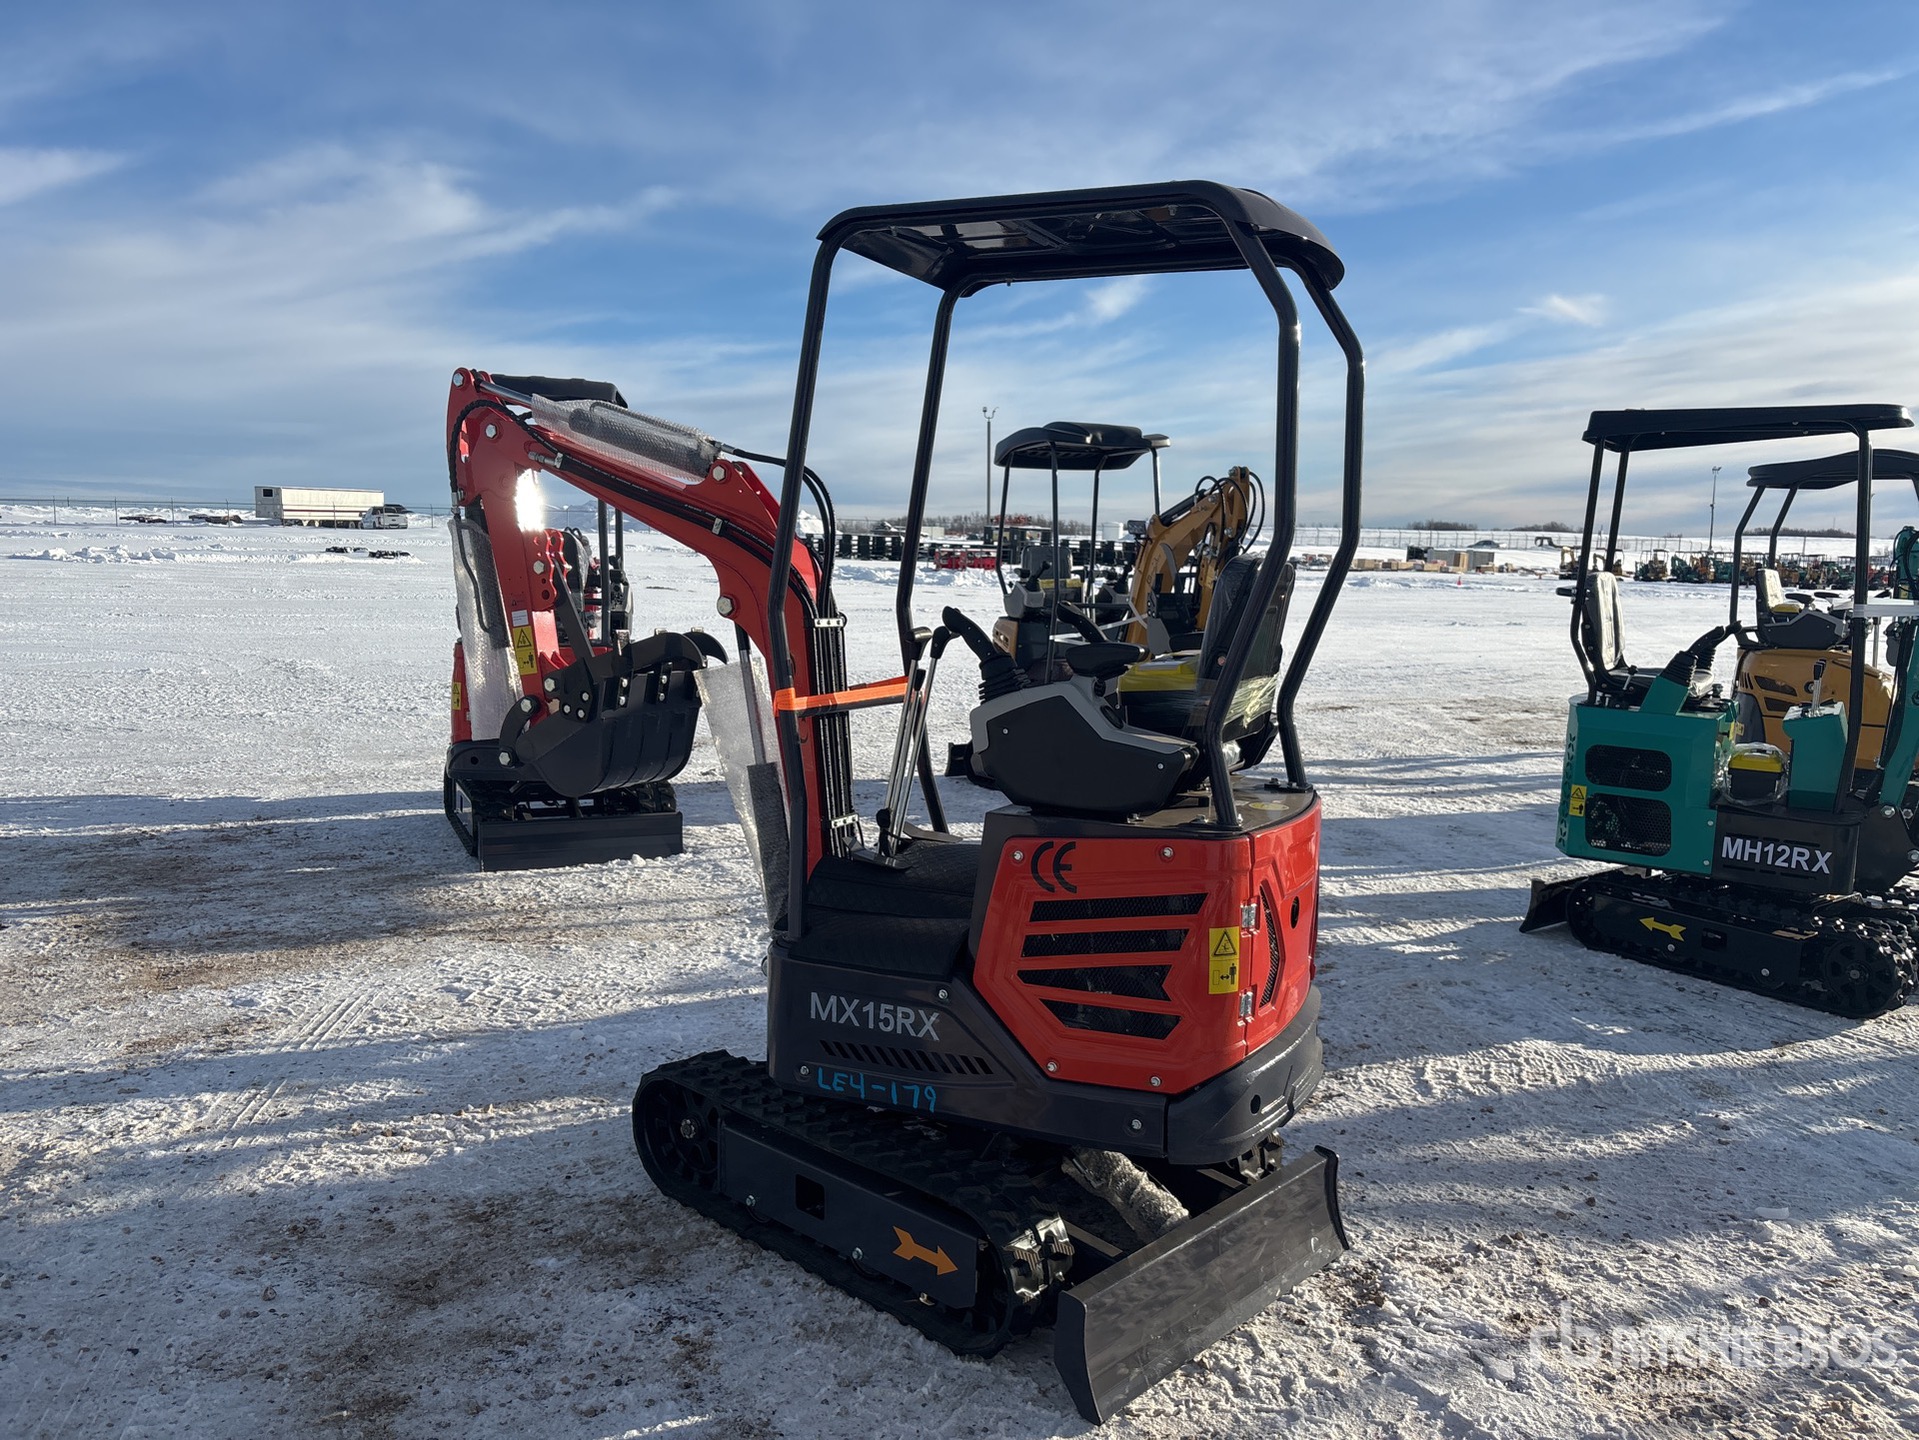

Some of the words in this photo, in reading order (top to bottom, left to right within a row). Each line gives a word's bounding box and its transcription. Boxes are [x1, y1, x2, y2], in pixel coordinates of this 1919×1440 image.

[1031, 841, 1078, 894] CE
[1721, 836, 1833, 874] MH12RX
[810, 992, 941, 1042] MX15RX
[817, 1066, 937, 1114] LE4-179
